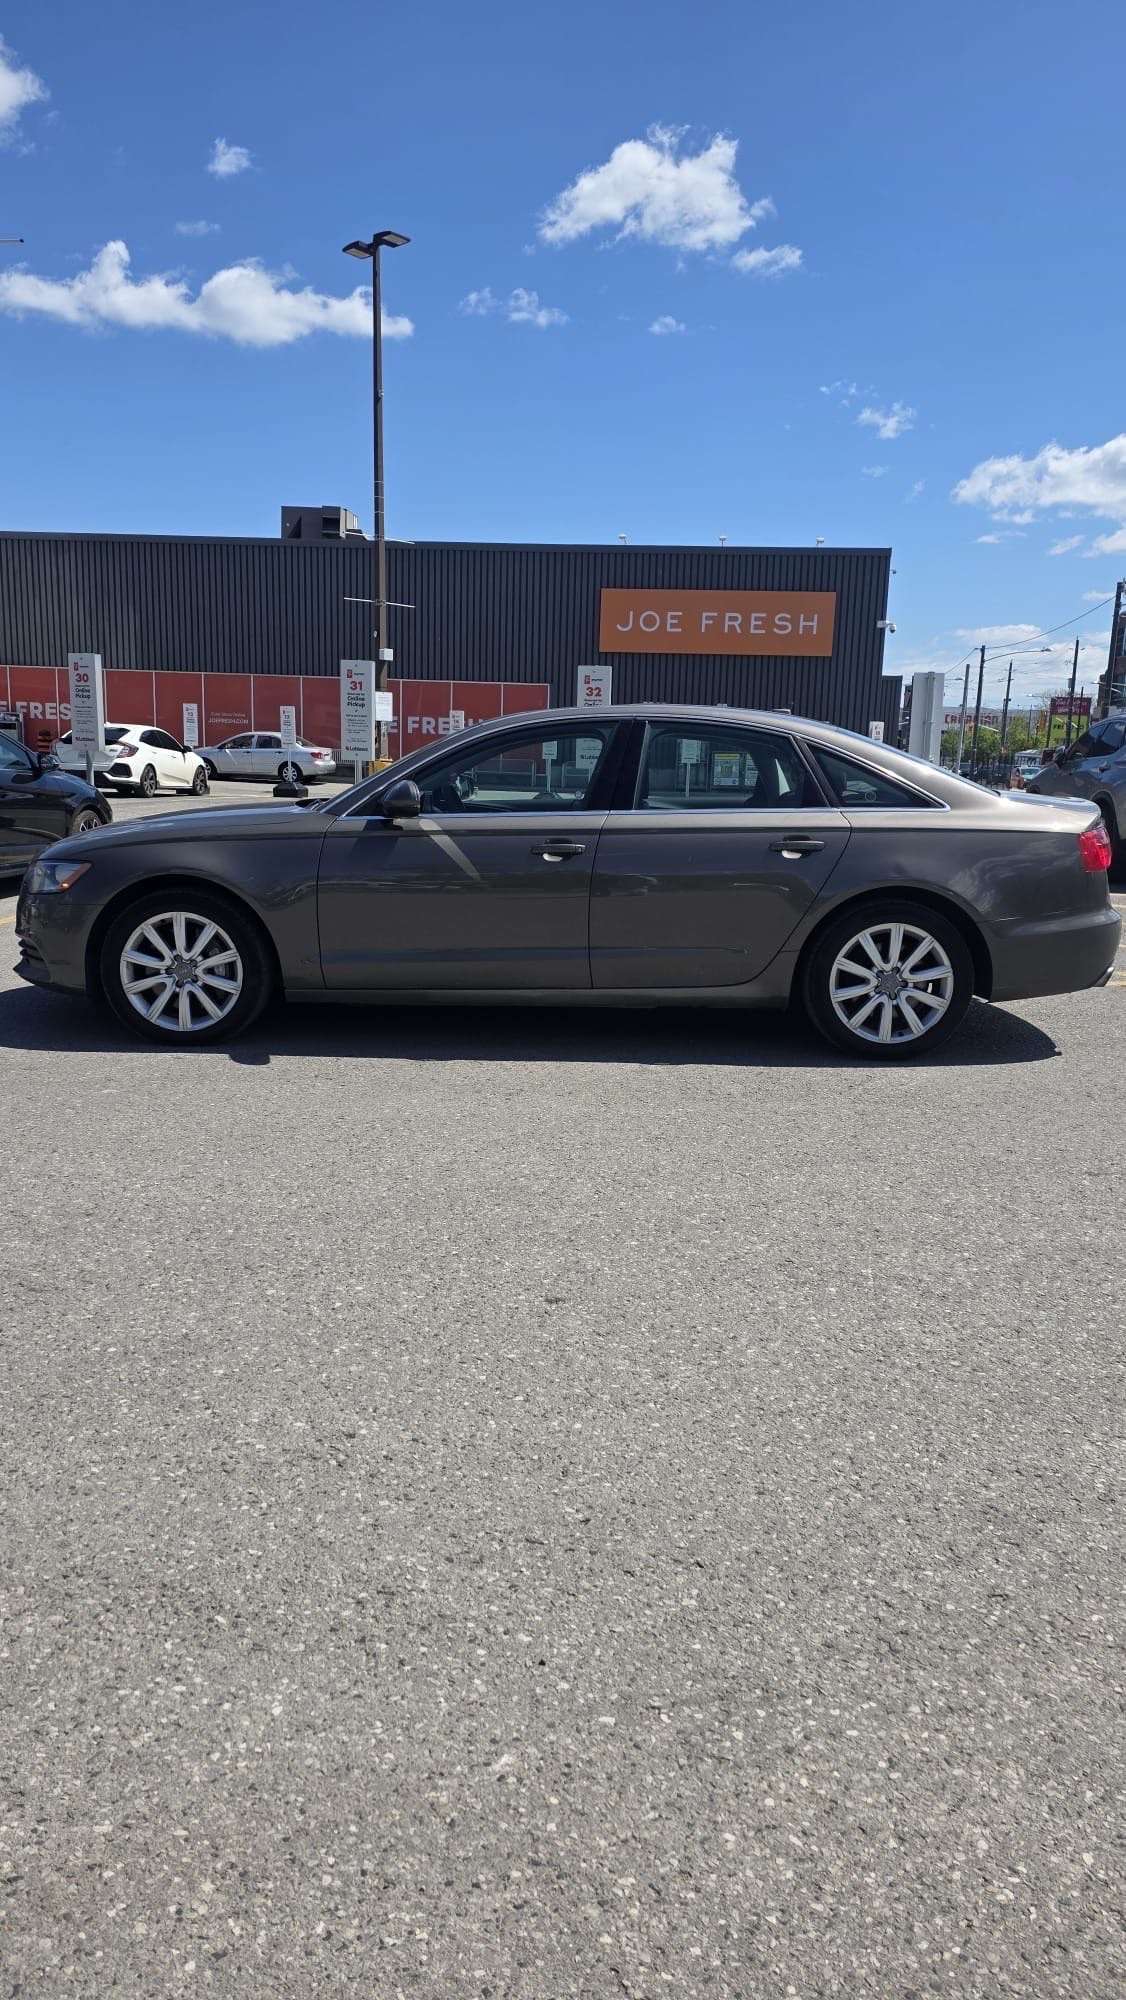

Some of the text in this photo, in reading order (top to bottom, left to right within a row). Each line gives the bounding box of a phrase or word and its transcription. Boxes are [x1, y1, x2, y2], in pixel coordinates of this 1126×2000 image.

[616, 611, 819, 636] JOE FRESH
[75, 673, 89, 683] 30
[350, 680, 363, 691] 31
[586, 687, 602, 697] 32
[16, 702, 72, 720] FRES
